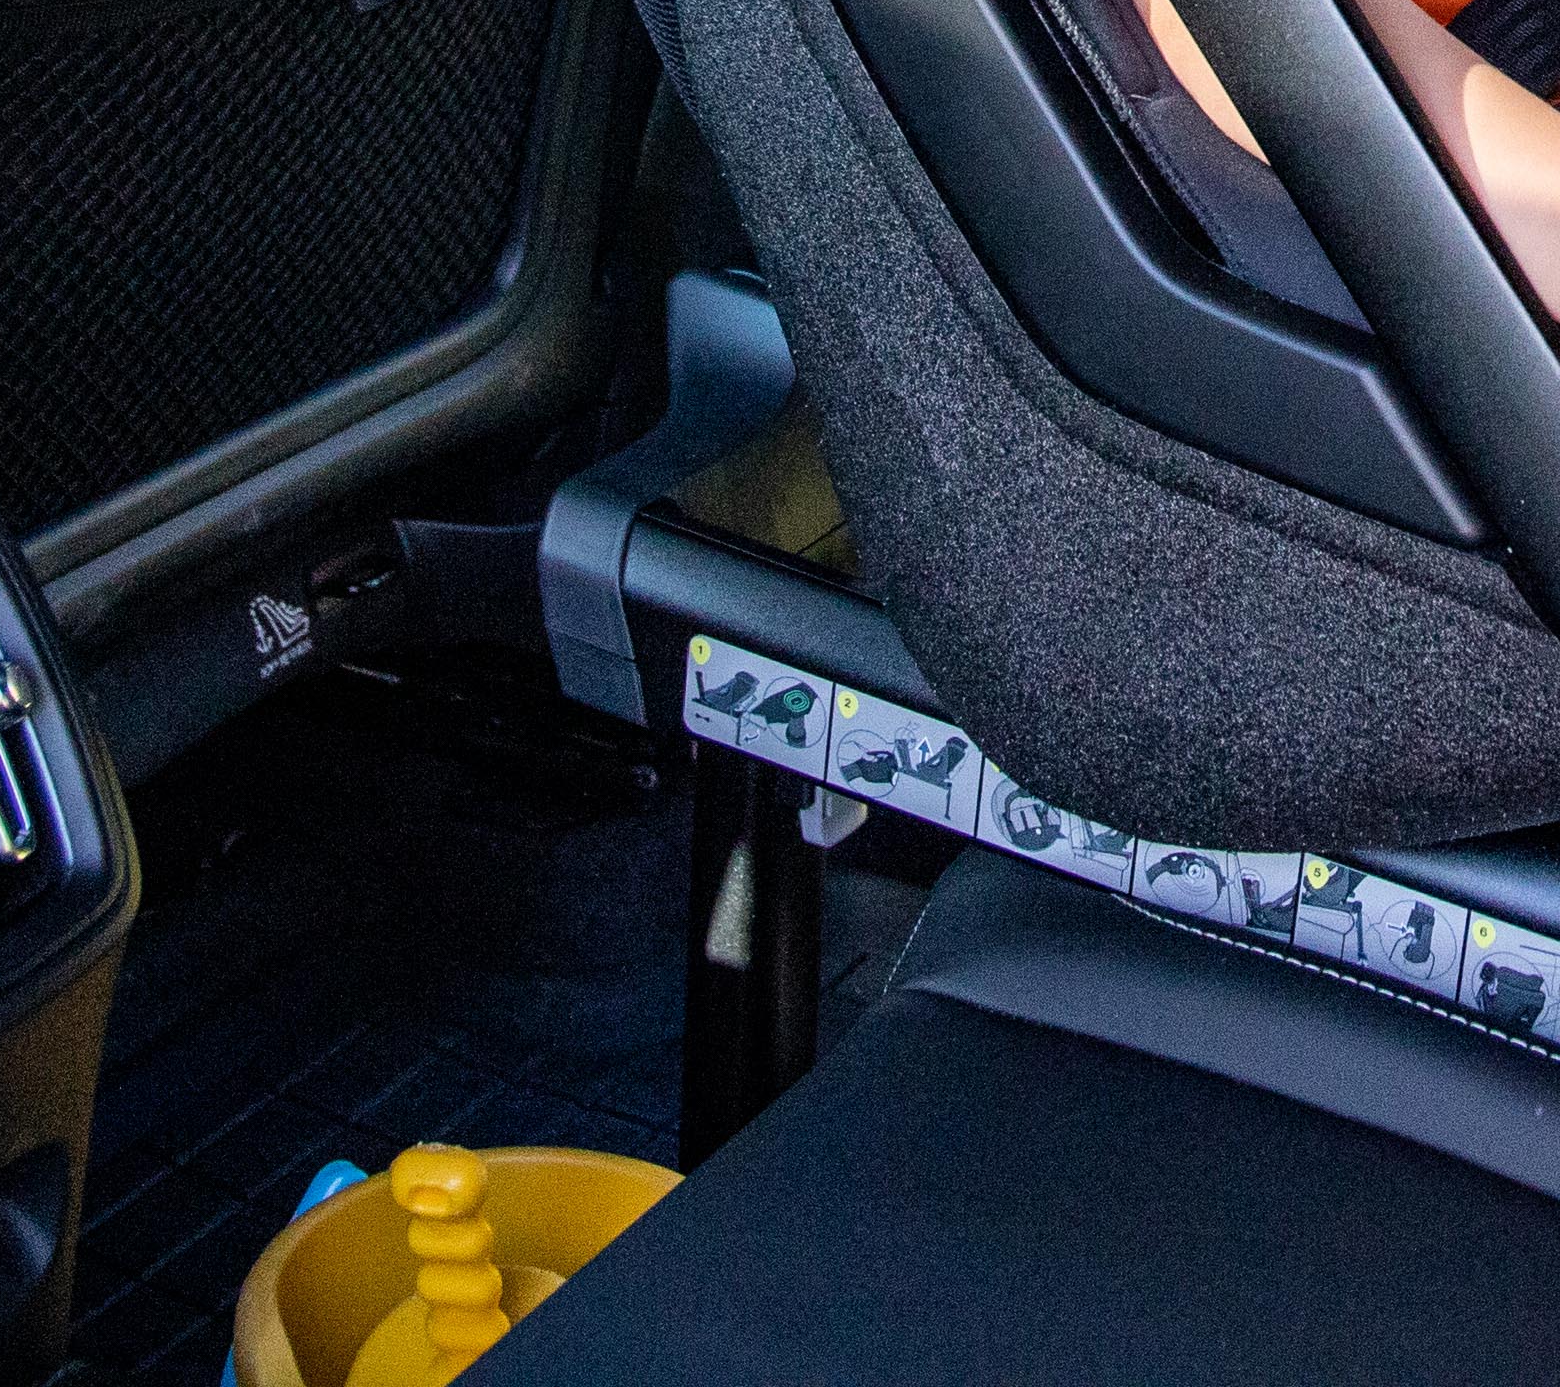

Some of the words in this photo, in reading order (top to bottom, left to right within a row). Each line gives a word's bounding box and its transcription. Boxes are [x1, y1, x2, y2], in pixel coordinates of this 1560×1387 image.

[697, 645, 703, 655] 1
[844, 698, 851, 708] 2
[1313, 867, 1322, 878] 5
[1479, 927, 1488, 938] 6
